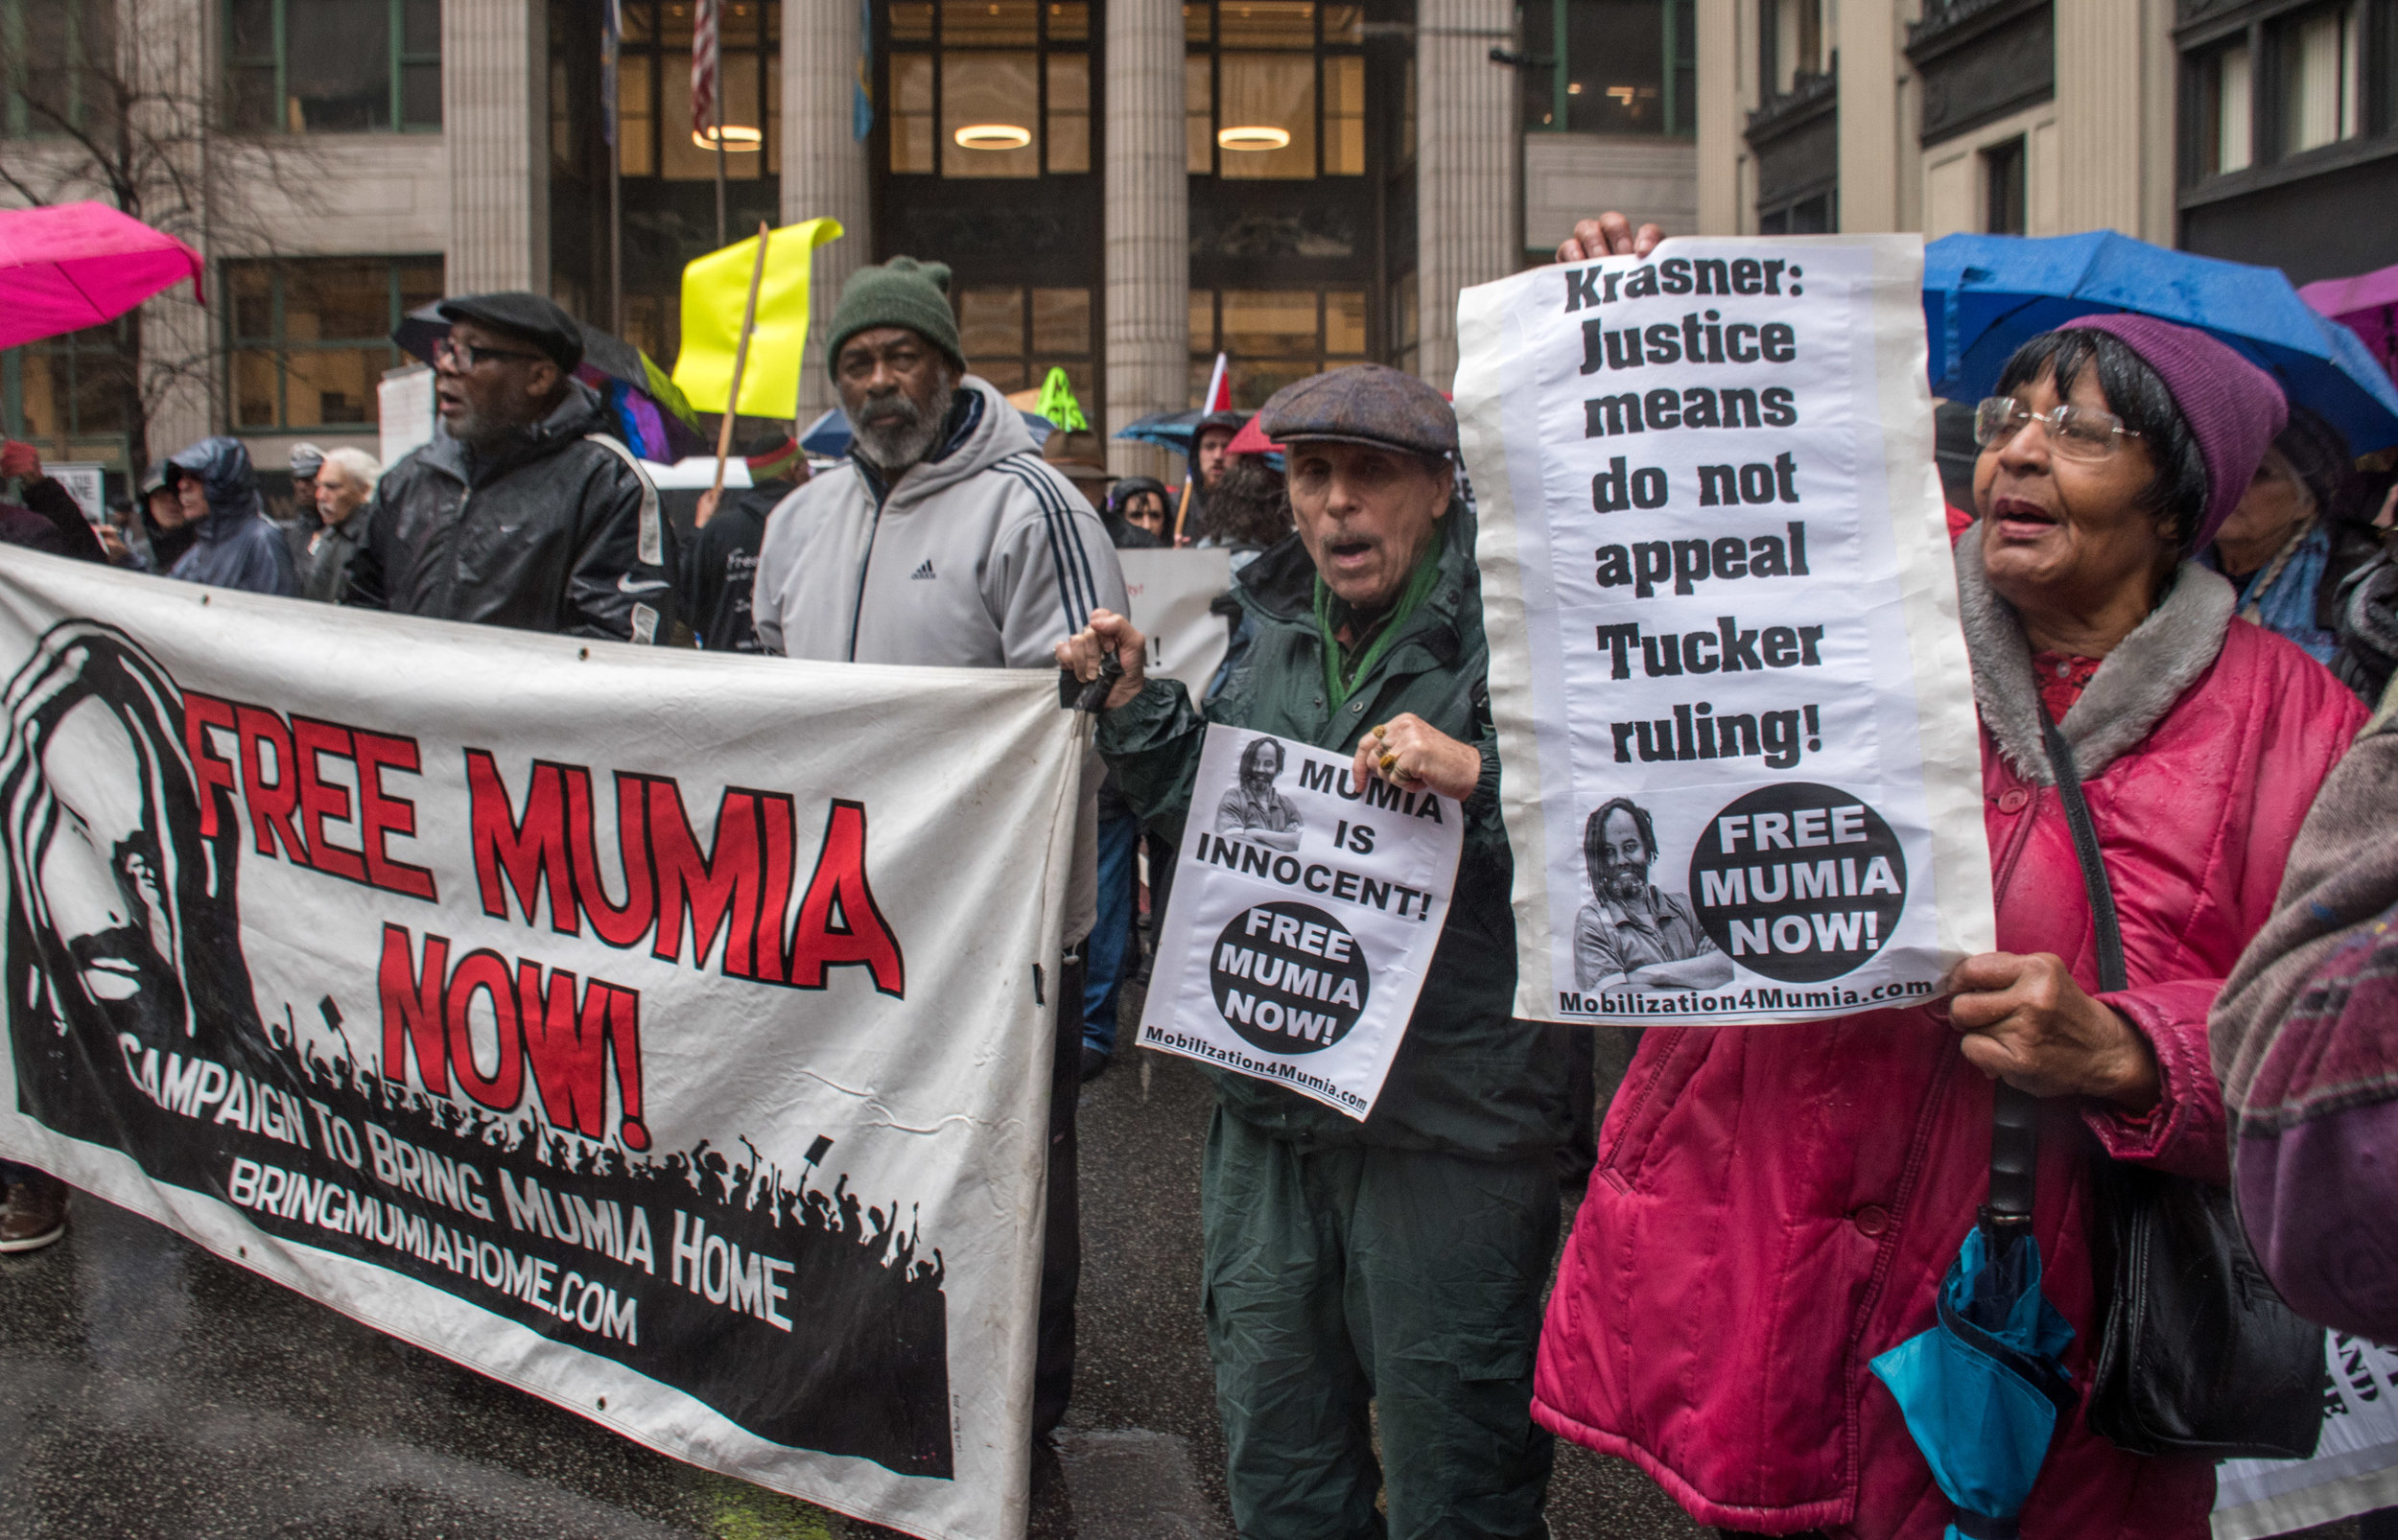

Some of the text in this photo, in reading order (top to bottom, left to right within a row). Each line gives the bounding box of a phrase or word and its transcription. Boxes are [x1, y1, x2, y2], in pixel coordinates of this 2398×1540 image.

[1564, 258, 1803, 314] Krasner:
[1580, 309, 1796, 375] Justice
[1585, 387, 1797, 438] means
[1592, 451, 1799, 513] do not
[1595, 521, 1809, 598] appeal
[1596, 616, 1823, 680] Tucker
[1610, 702, 1822, 769] ruling!
[180, 688, 905, 1000] FREE MUMIA
[1334, 819, 1375, 854] IS
[1718, 805, 1868, 854] FREE
[1196, 832, 1433, 922] INNOCENT!
[1701, 856, 1901, 906] MUMIA
[1245, 907, 1353, 963] FREE
[1728, 911, 1879, 956] NOW!
[1217, 943, 1360, 1010] MUMIA
[1560, 979, 1933, 1015] Mobilization4Mumia.com
[378, 921, 651, 1153] NOW!
[1224, 989, 1337, 1046] NOW!
[1146, 1026, 1368, 1111] Mobilization4Mumia.com
[118, 1032, 794, 1332] CAMPAIGN TO BRING MUMIA HOME
[229, 1157, 637, 1345] BRINGMUMIAHOME.COM
